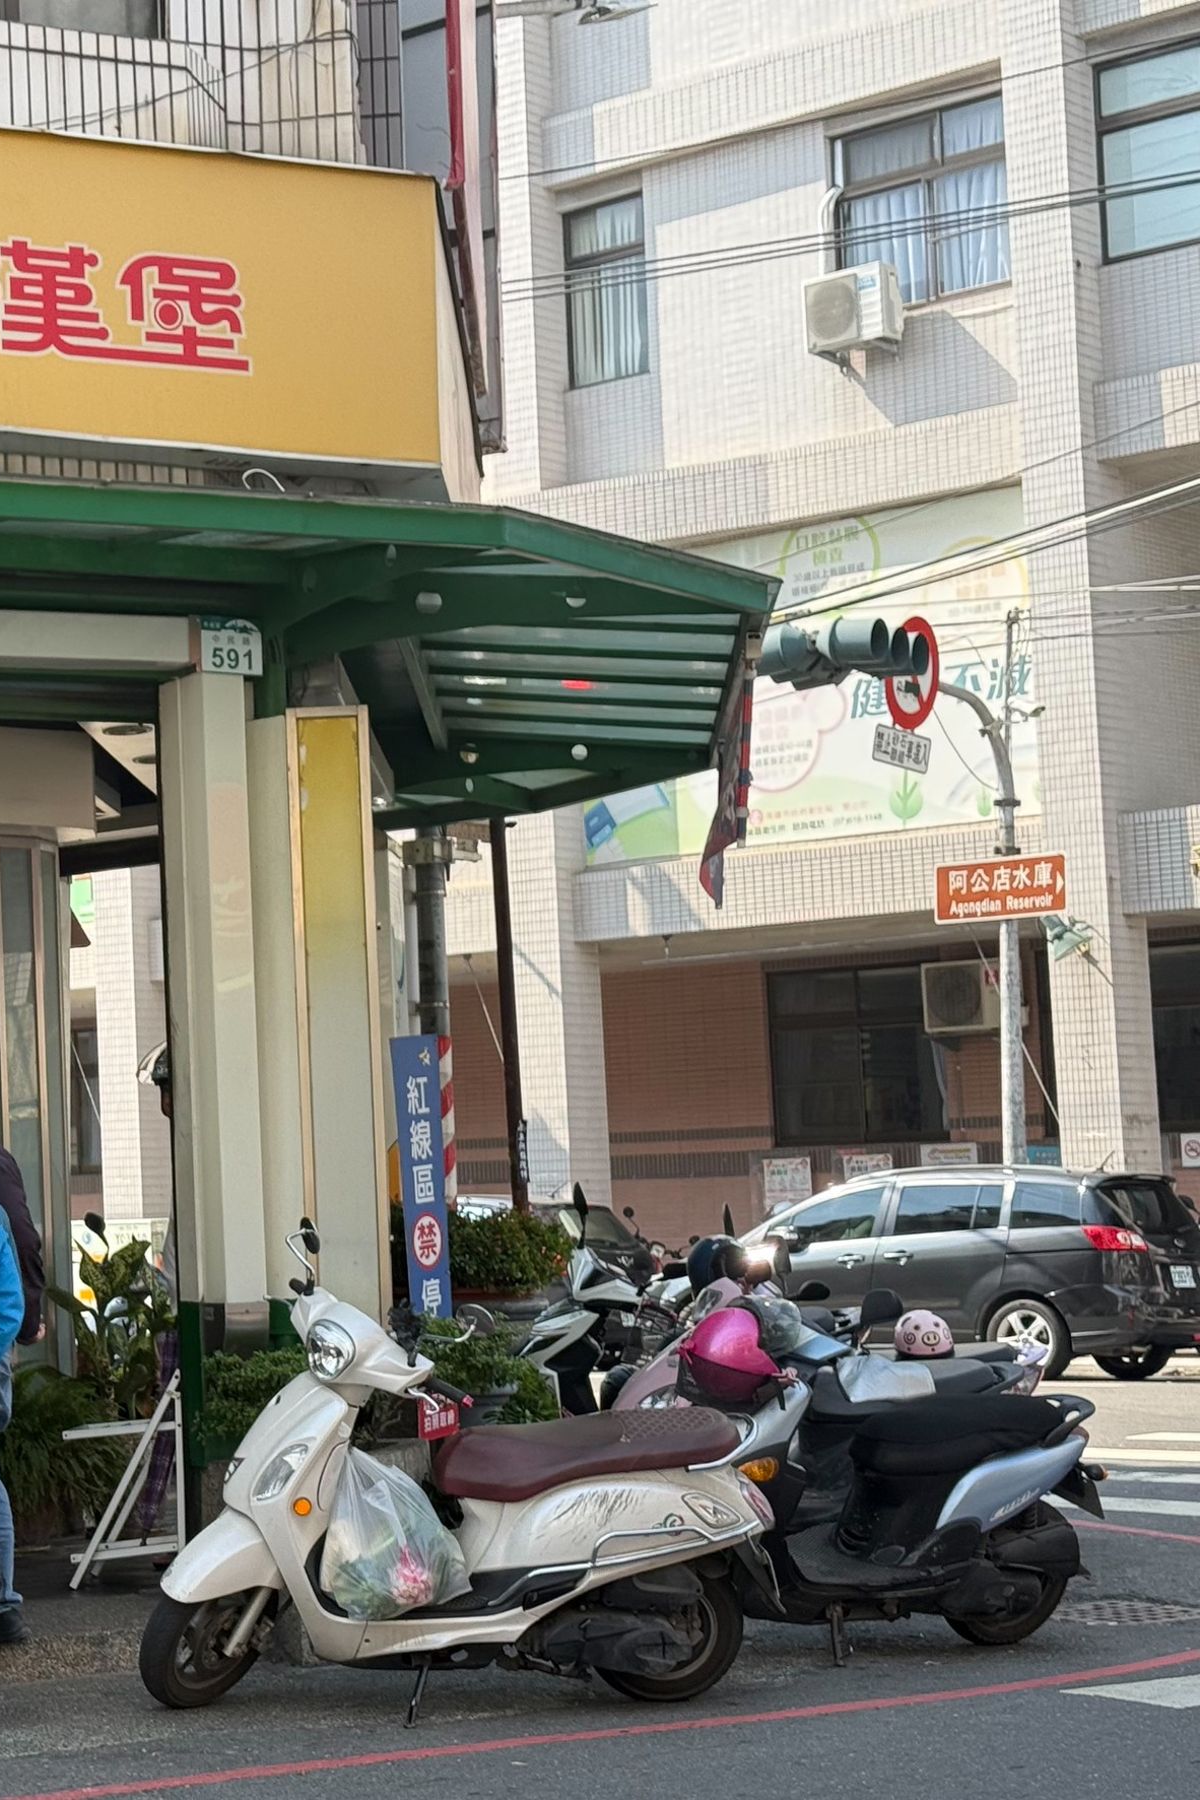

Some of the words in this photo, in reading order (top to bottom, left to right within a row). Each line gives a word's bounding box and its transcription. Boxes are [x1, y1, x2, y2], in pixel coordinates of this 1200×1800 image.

[211, 647, 253, 671] 591
[949, 861, 1053, 896] 阿公店水庫
[949, 896, 1002, 917] Agongdian
[1006, 891, 1054, 911] Reservoir
